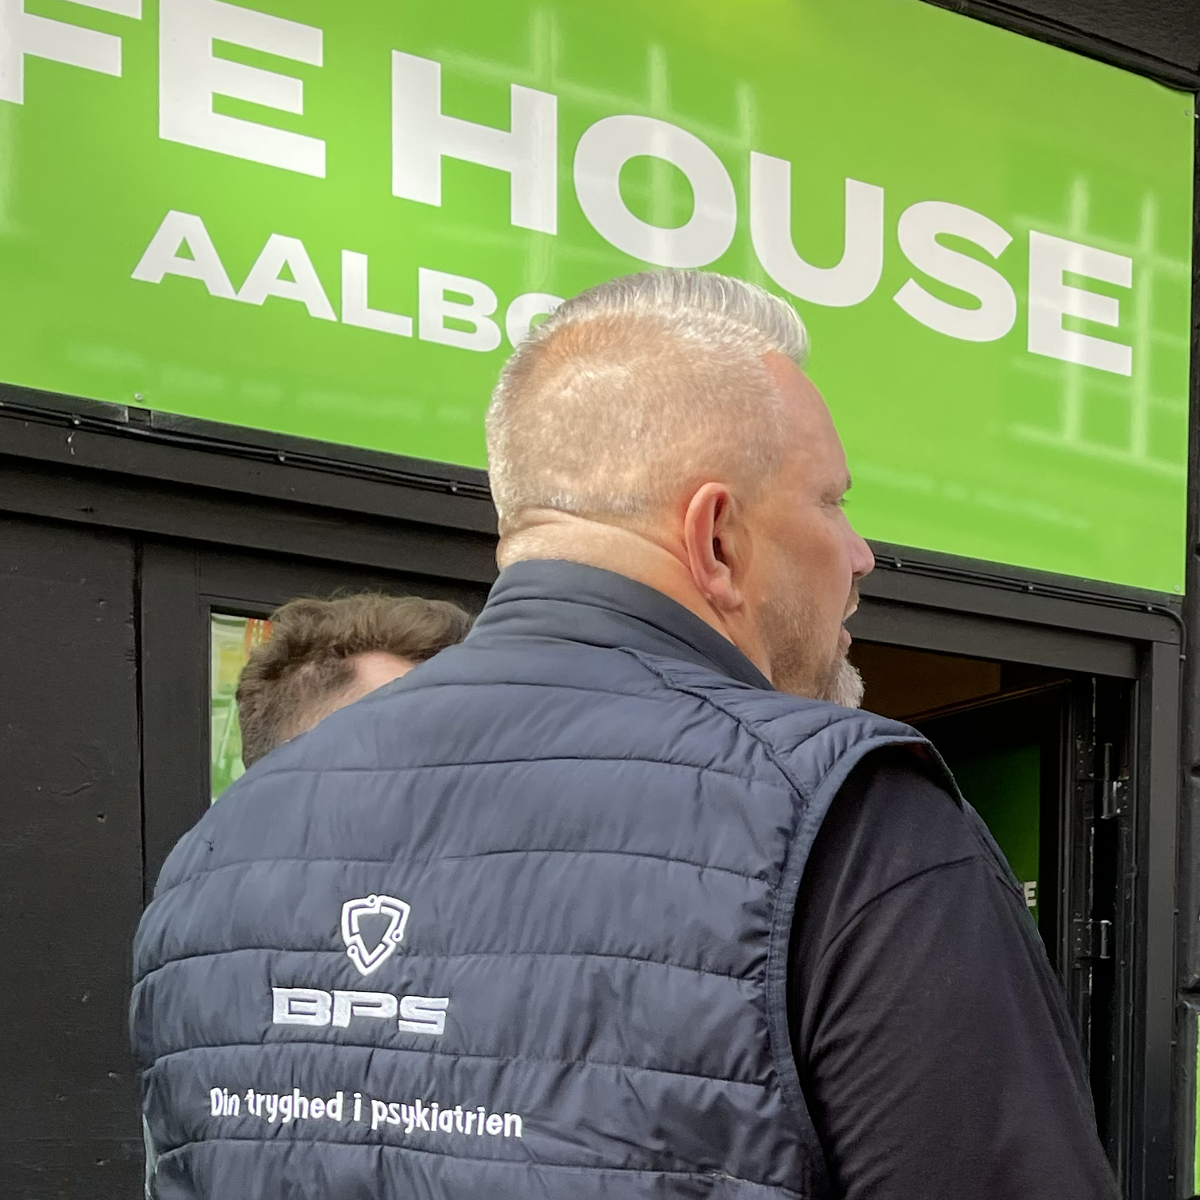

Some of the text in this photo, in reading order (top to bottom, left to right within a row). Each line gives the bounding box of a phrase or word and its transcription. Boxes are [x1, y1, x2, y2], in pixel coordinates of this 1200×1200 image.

[391, 49, 1133, 377] HOUSE
[271, 986, 450, 1036] BPS
[210, 1086, 523, 1138] Din tryghed i psykiatrien
